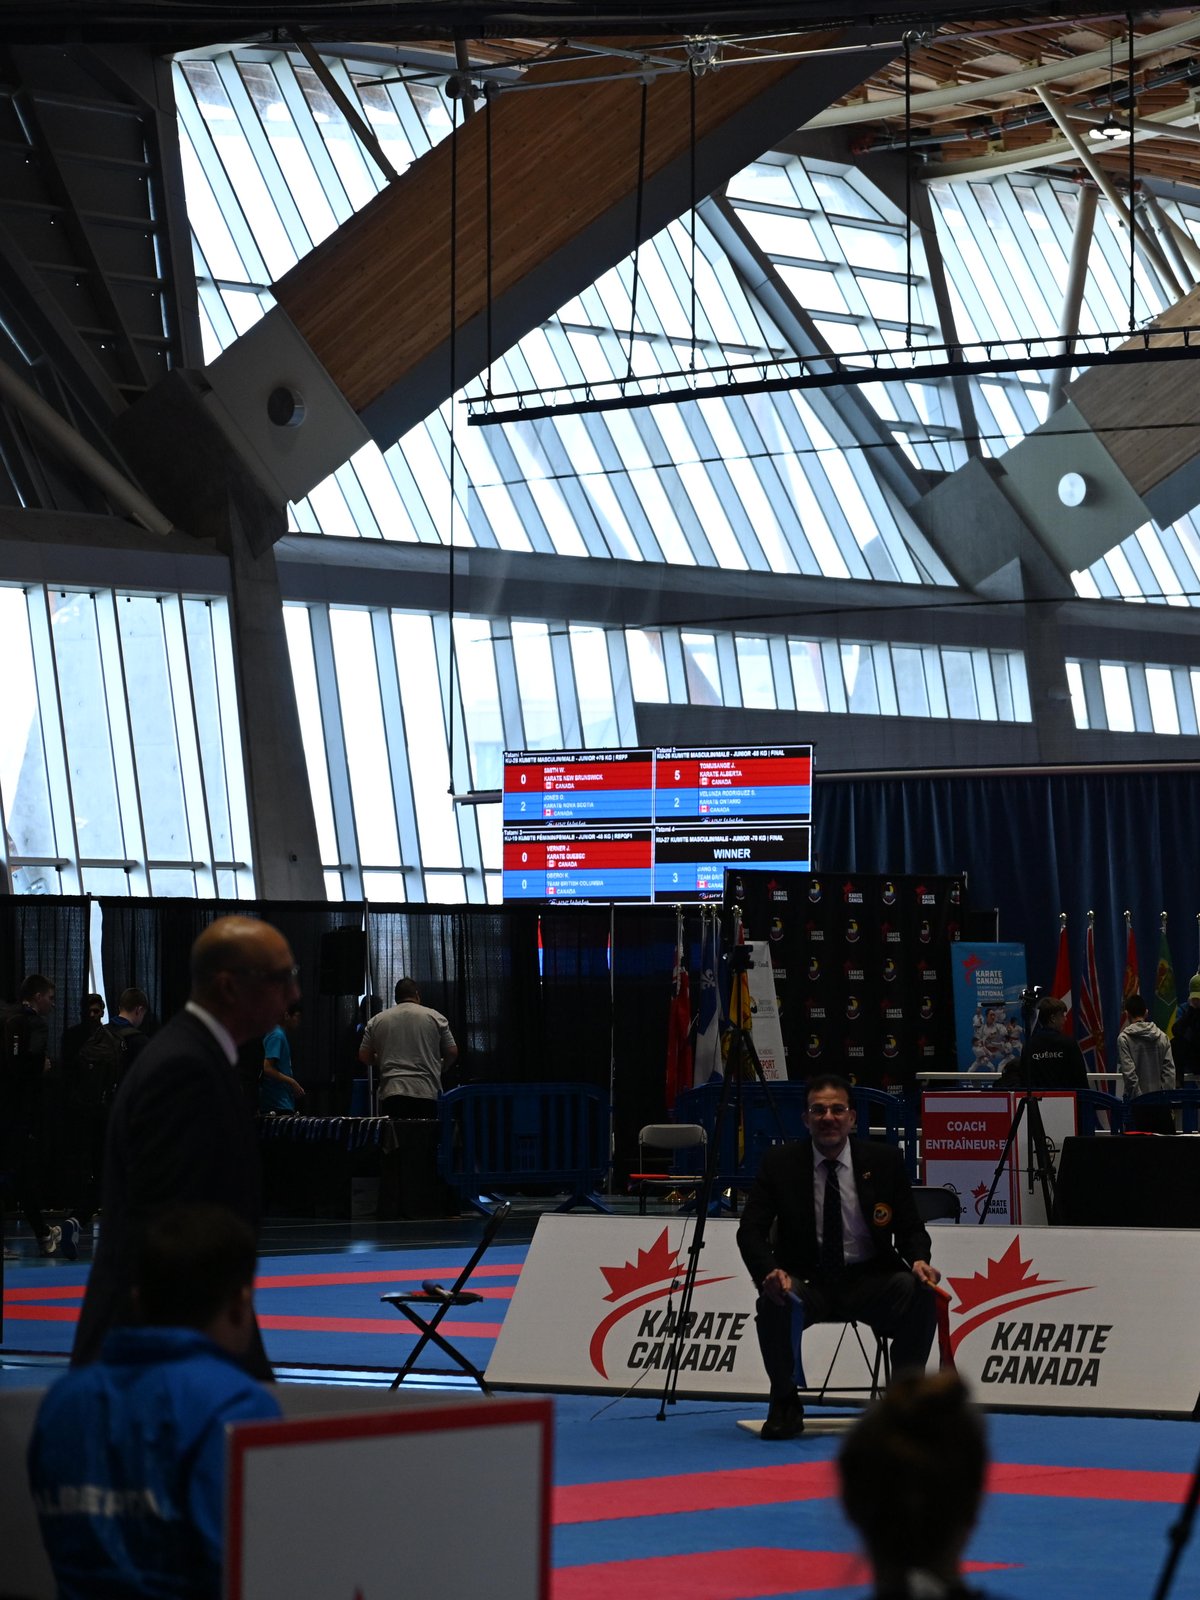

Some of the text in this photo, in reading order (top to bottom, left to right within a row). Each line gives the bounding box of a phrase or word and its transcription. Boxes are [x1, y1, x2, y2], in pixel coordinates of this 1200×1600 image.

[520, 774, 526, 784] 0
[674, 770, 680, 780] 5
[520, 802, 526, 811] 2
[674, 798, 680, 808] 2
[522, 852, 528, 862] 0
[713, 848, 751, 859] WINNER
[672, 873, 678, 883] 3
[522, 879, 527, 890] 0
[1032, 1050, 1064, 1061] QUÉBEC
[946, 1121, 986, 1131] COACH
[637, 1310, 750, 1340] KARATE
[991, 1322, 1113, 1353] KARATE
[627, 1342, 737, 1372] CANADA
[981, 1355, 1100, 1386] CANADA
